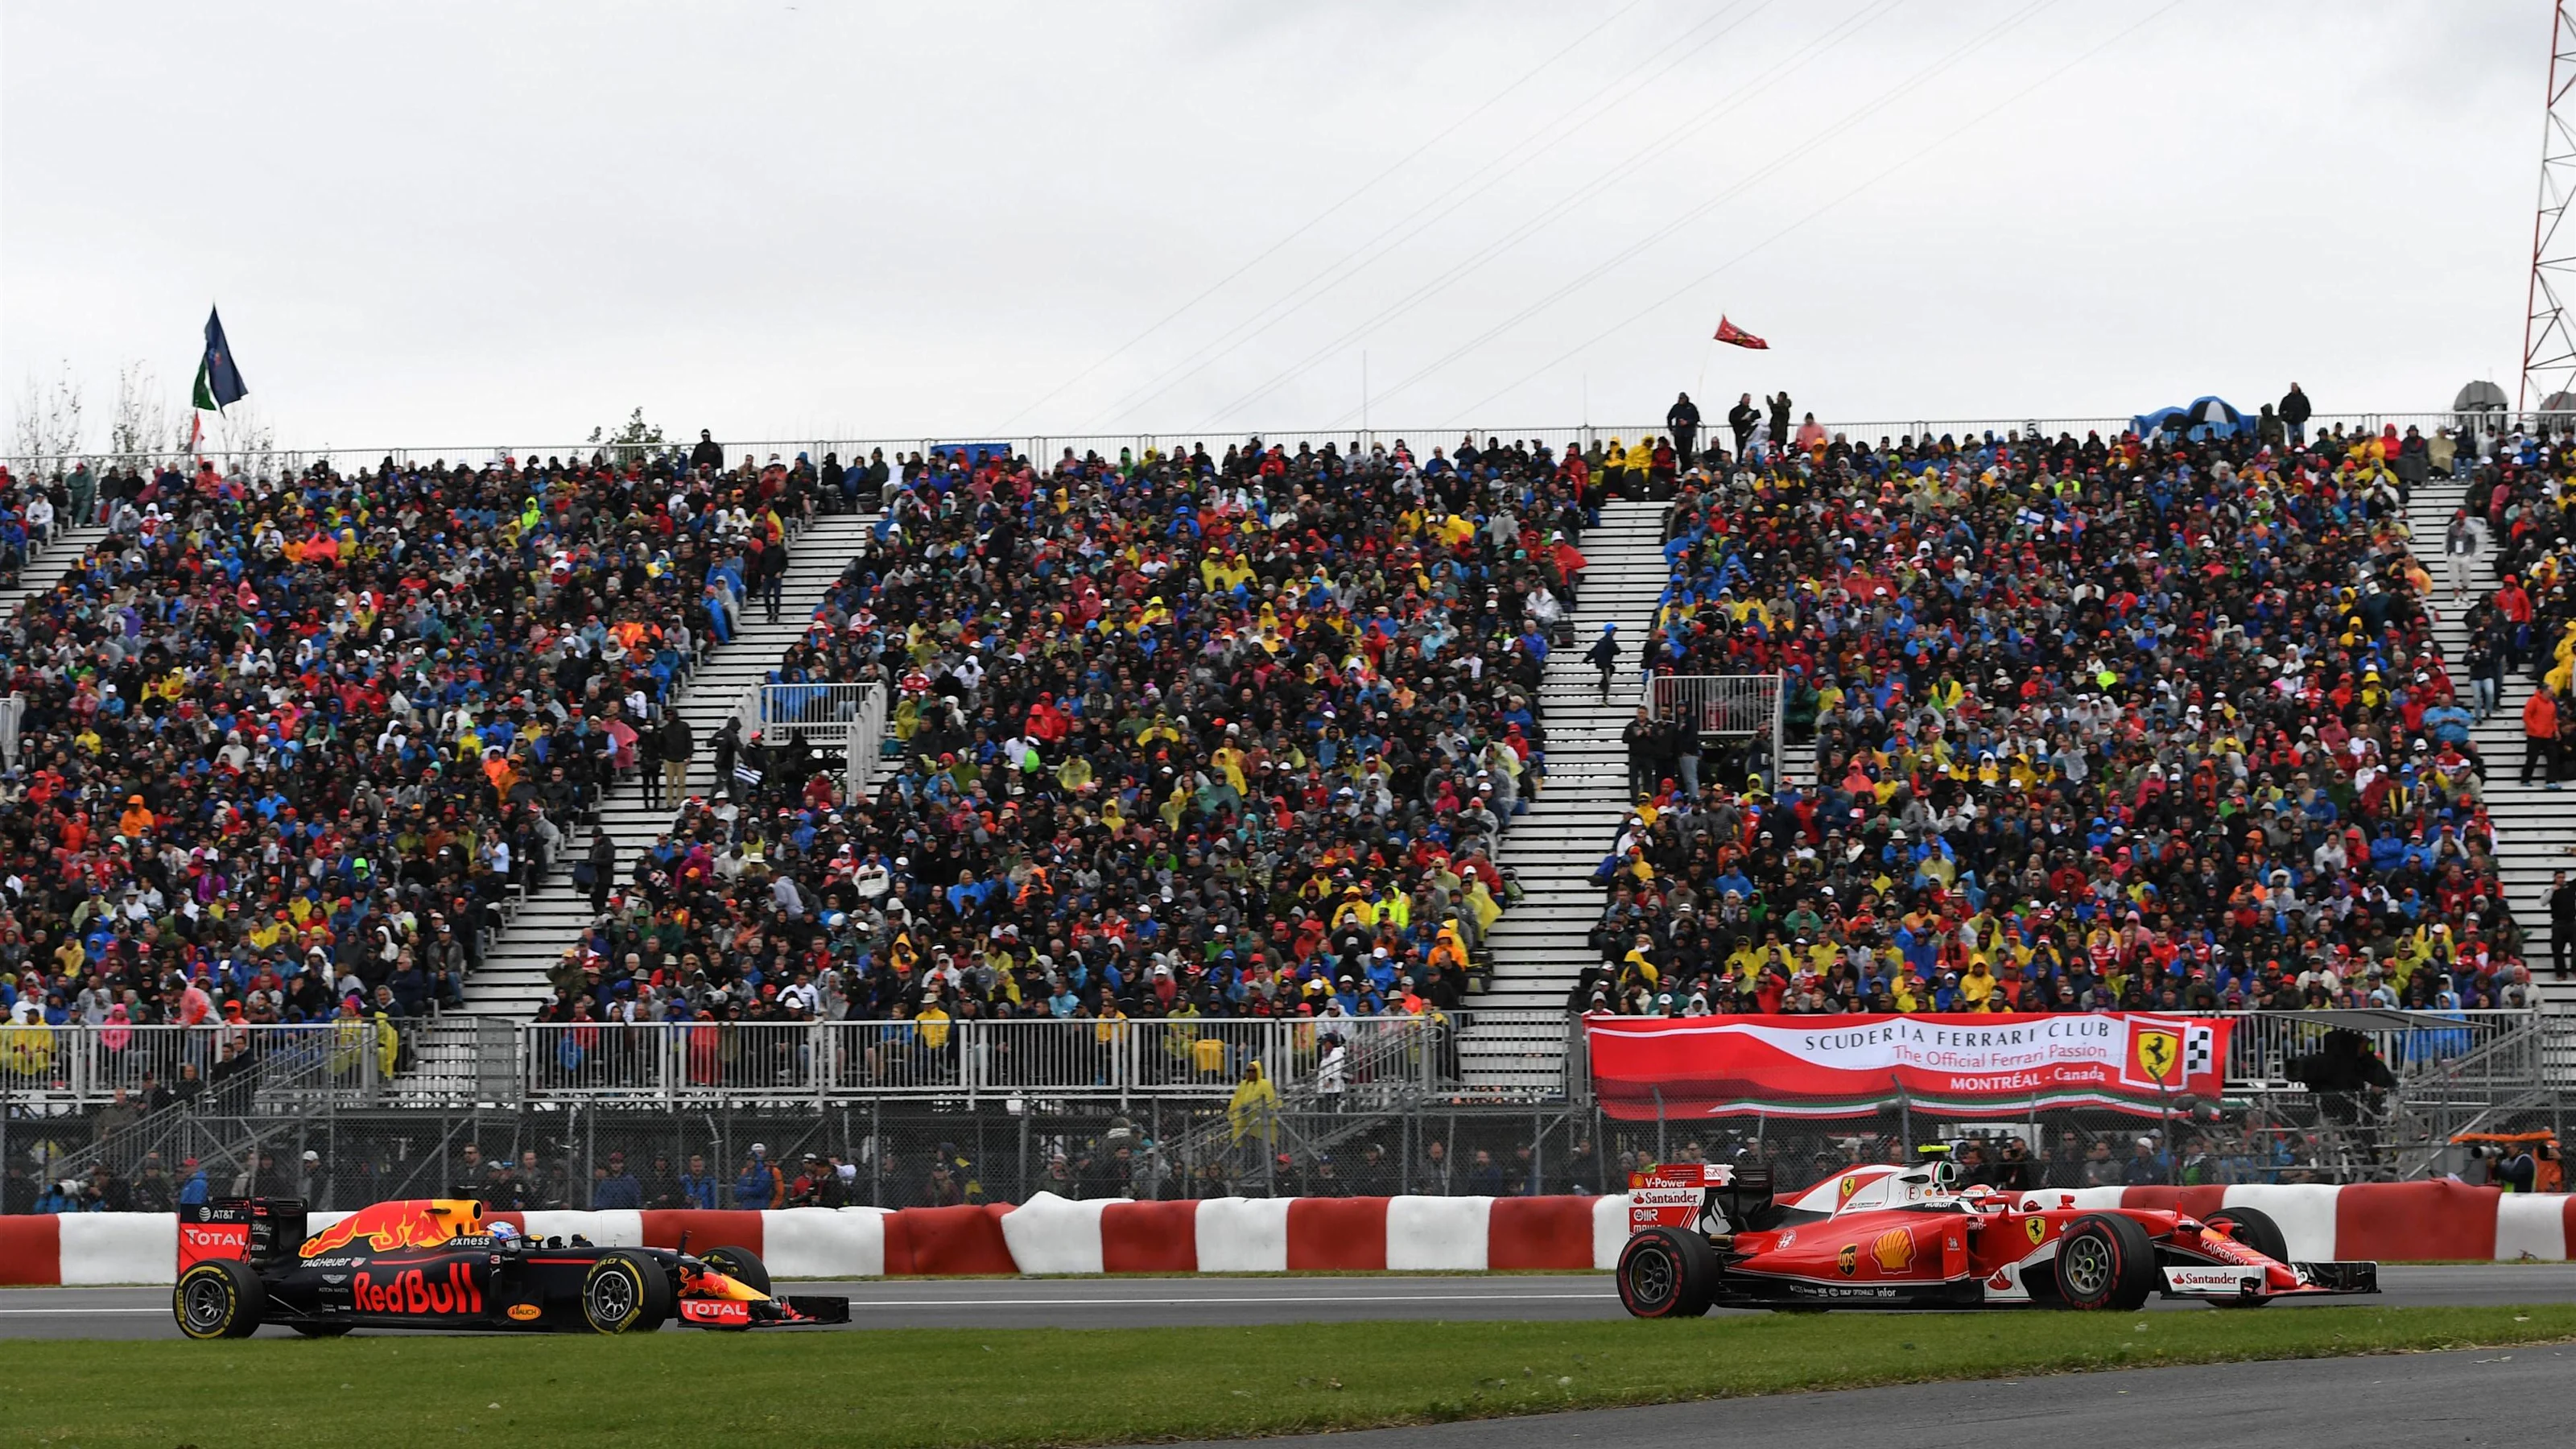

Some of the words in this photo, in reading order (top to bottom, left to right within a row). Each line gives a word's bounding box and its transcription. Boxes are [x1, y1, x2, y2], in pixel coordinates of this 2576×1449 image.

[2027, 423, 2037, 437] 5
[499, 452, 507, 463] 3
[1805, 1025, 1924, 1051] SCUDERIA
[1938, 1029, 2034, 1046] FERRARI
[2049, 1022, 2108, 1038] CLUB
[1893, 1045, 1922, 1063] The
[1926, 1051, 1985, 1068] Official
[1992, 1046, 2043, 1067] Ferrari
[2050, 1042, 2106, 1059] Passion
[1951, 1072, 2041, 1090] MONTRÉAL
[2054, 1066, 2105, 1082] Canada
[1645, 1178, 1686, 1187] V-Power
[1645, 1191, 1698, 1203] Santander
[1909, 1187, 1915, 1199] E
[213, 1210, 235, 1220] AT&T
[184, 1228, 246, 1246] TOTAL
[450, 1237, 490, 1246] exness
[2201, 1239, 2244, 1265] KASPERSKY
[490, 1255, 501, 1264] 3
[1839, 1252, 1855, 1272] ups
[2186, 1273, 2237, 1284] Santander
[1876, 1287, 1896, 1296] infor
[682, 1301, 748, 1315] TOTAL
